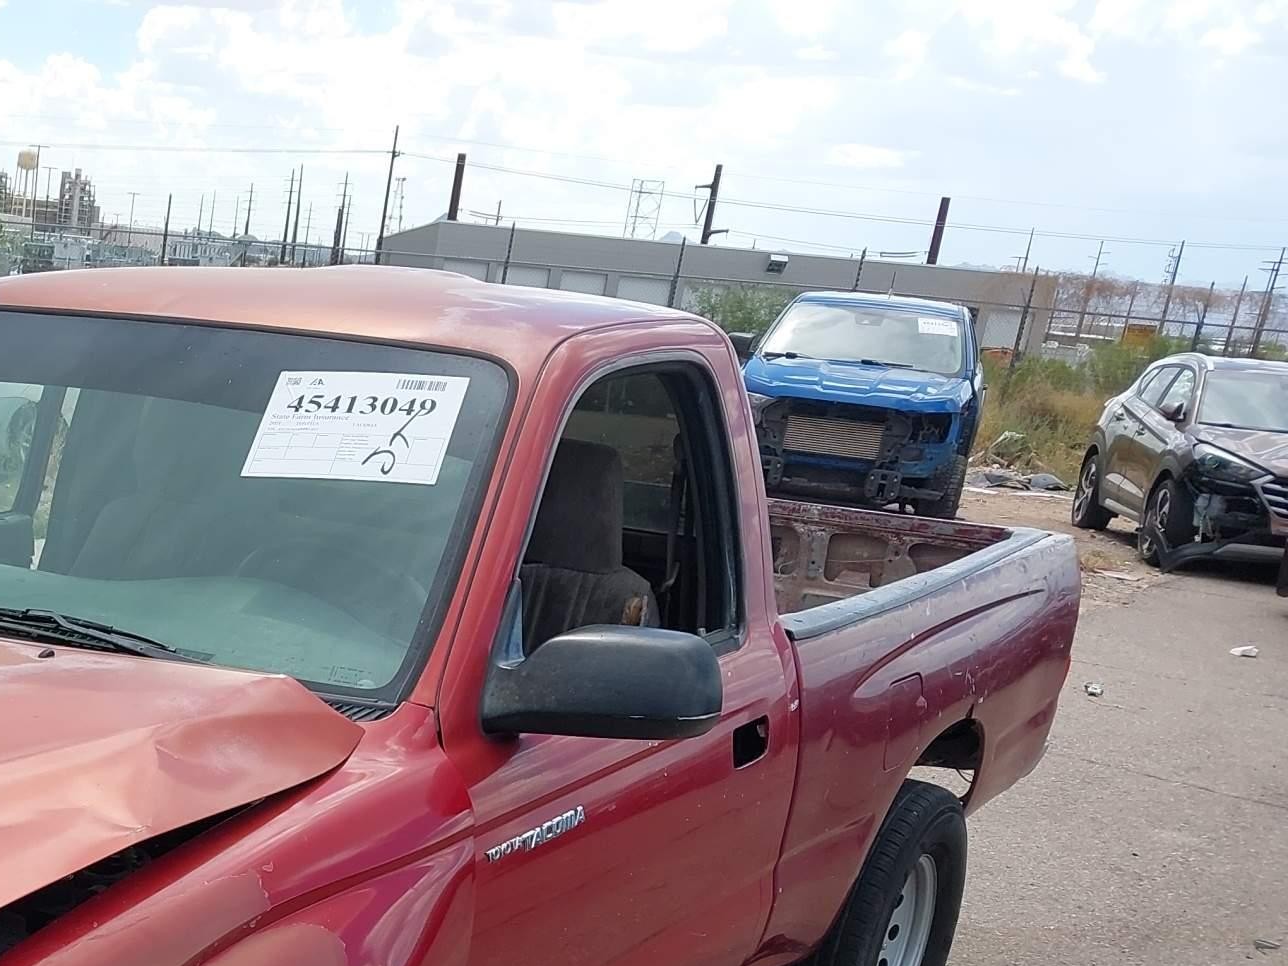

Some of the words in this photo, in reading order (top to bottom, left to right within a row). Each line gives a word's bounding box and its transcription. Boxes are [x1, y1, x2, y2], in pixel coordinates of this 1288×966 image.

[286, 394, 438, 418] 45413049
[484, 836, 523, 864] TOYOTA
[522, 805, 586, 853] TACOMA
